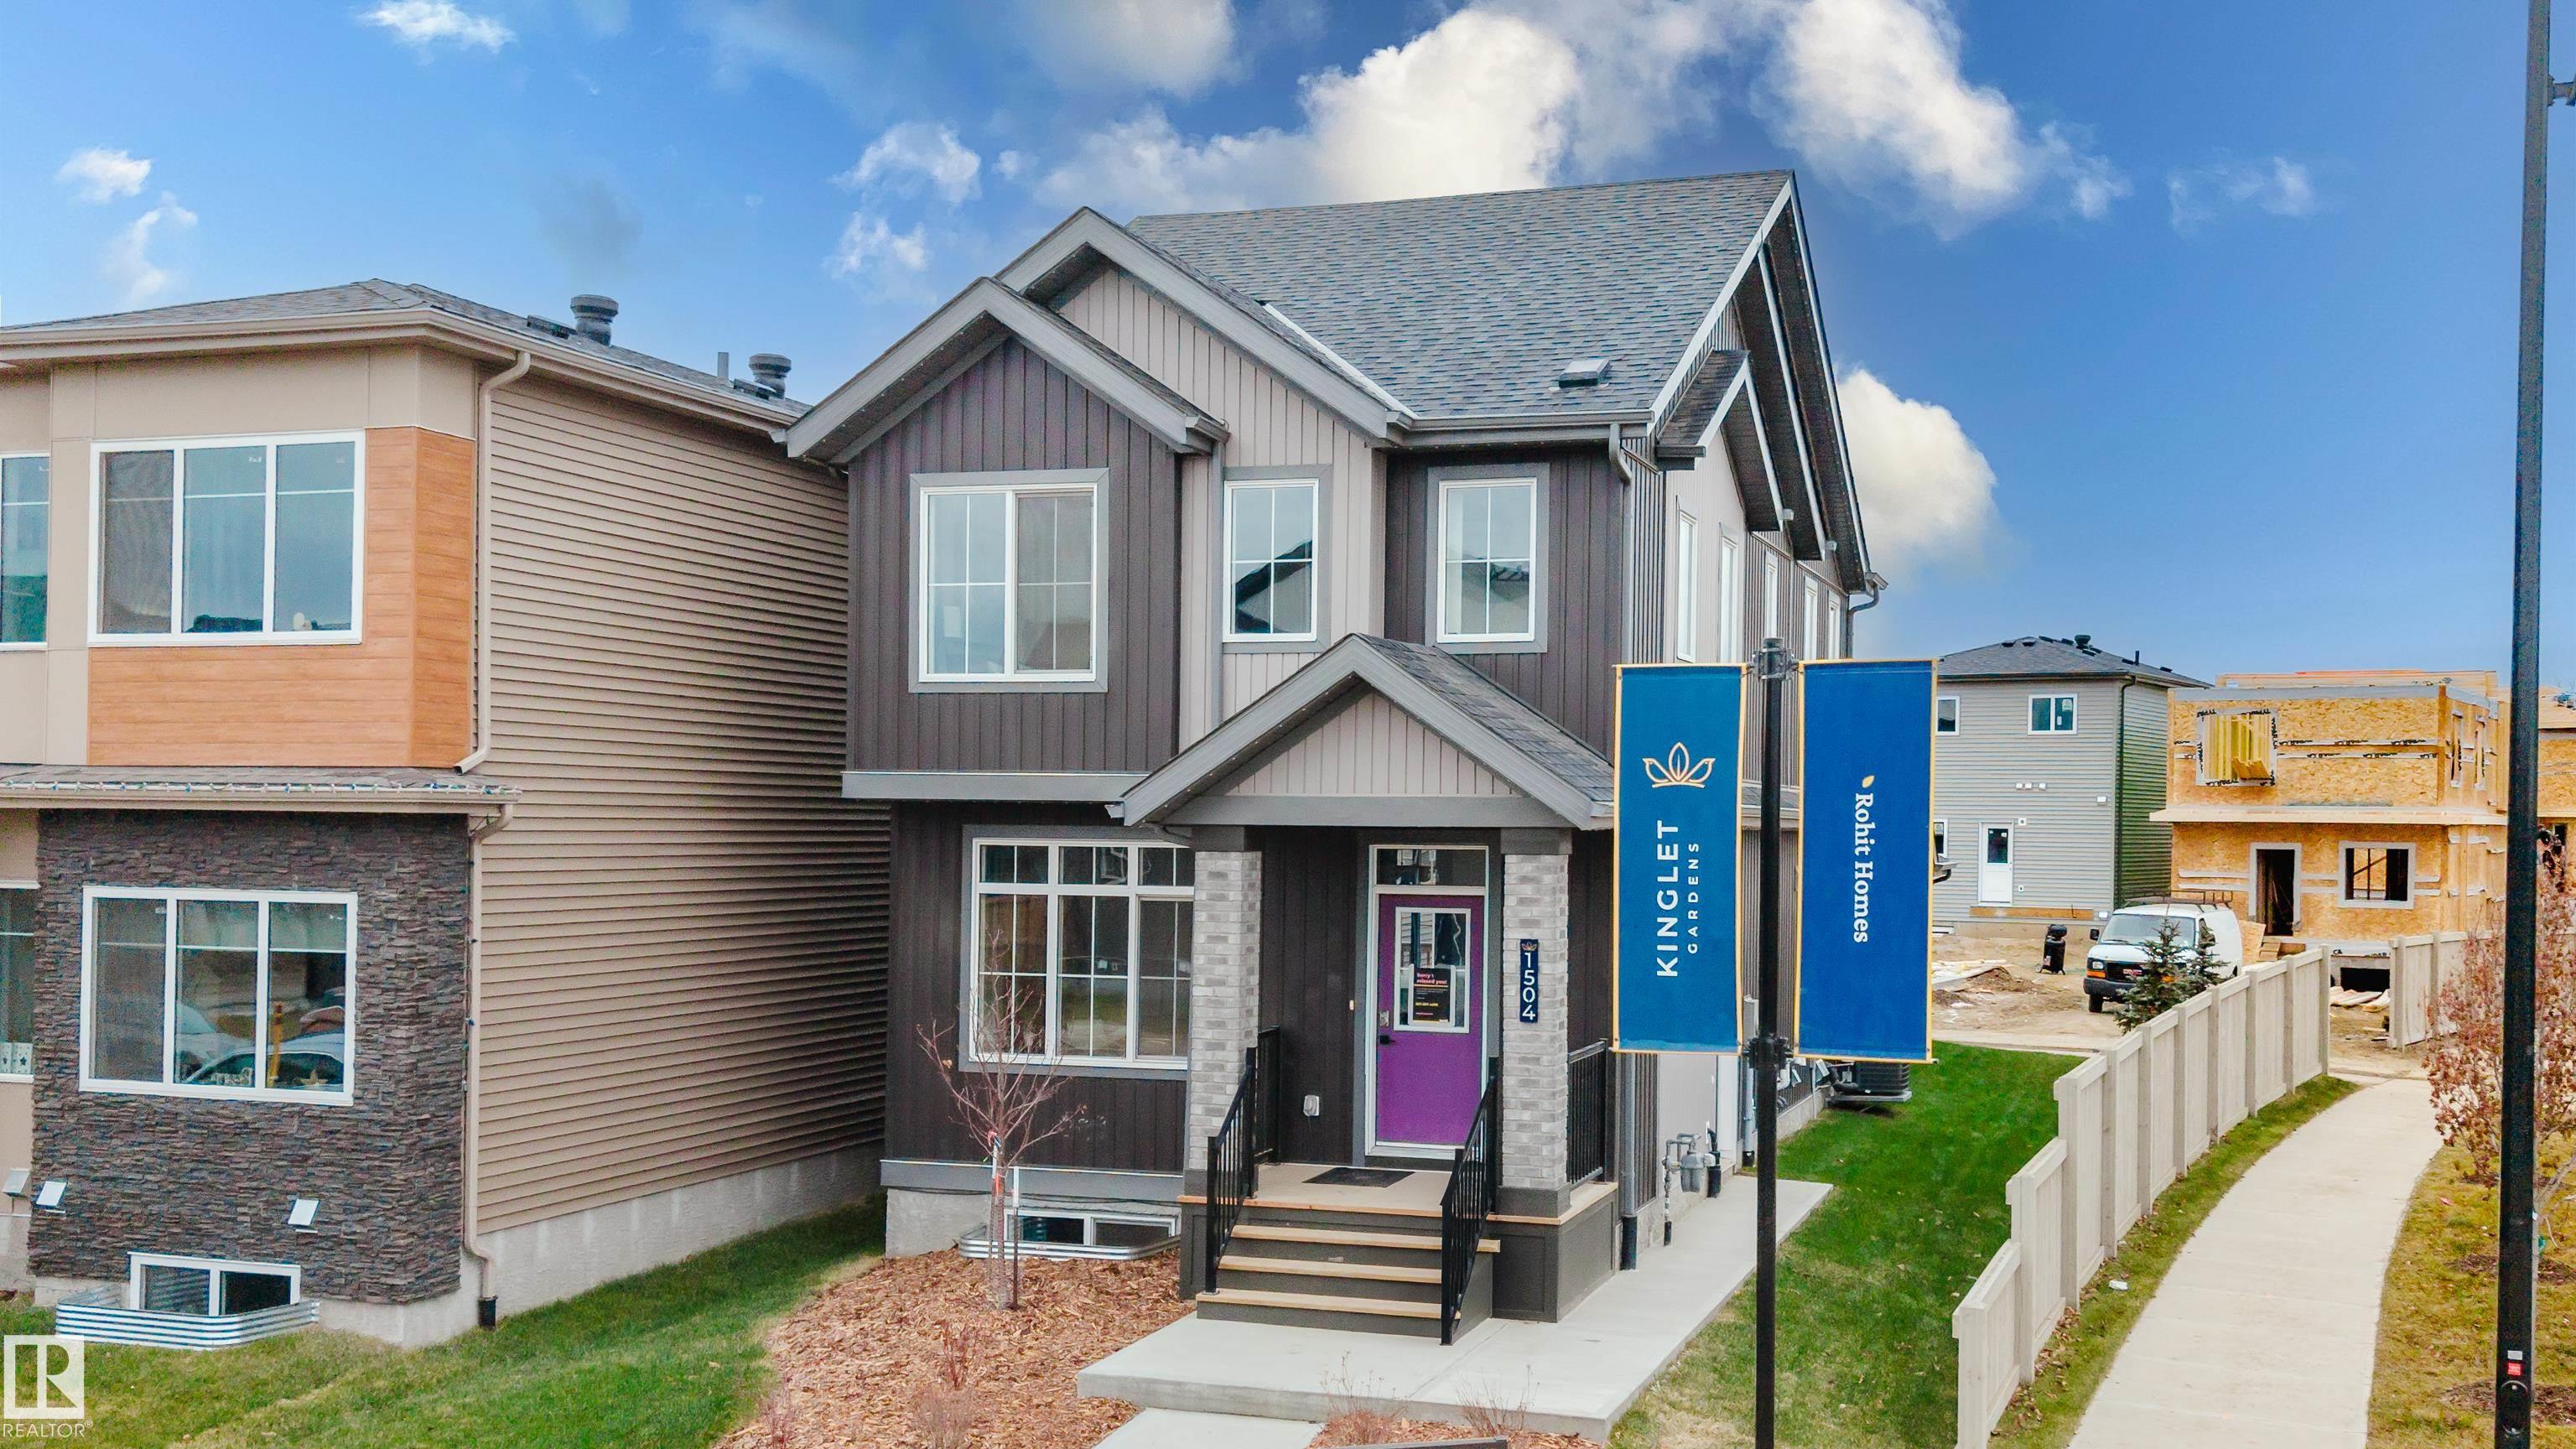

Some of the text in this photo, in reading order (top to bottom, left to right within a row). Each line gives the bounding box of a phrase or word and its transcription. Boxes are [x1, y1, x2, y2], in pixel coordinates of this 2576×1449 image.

[1656, 819, 1679, 977] KINGLET
[1687, 843, 1700, 954] GARDENS
[1853, 792, 1876, 943] Rohit Homes
[1522, 952, 1536, 1021] 1504
